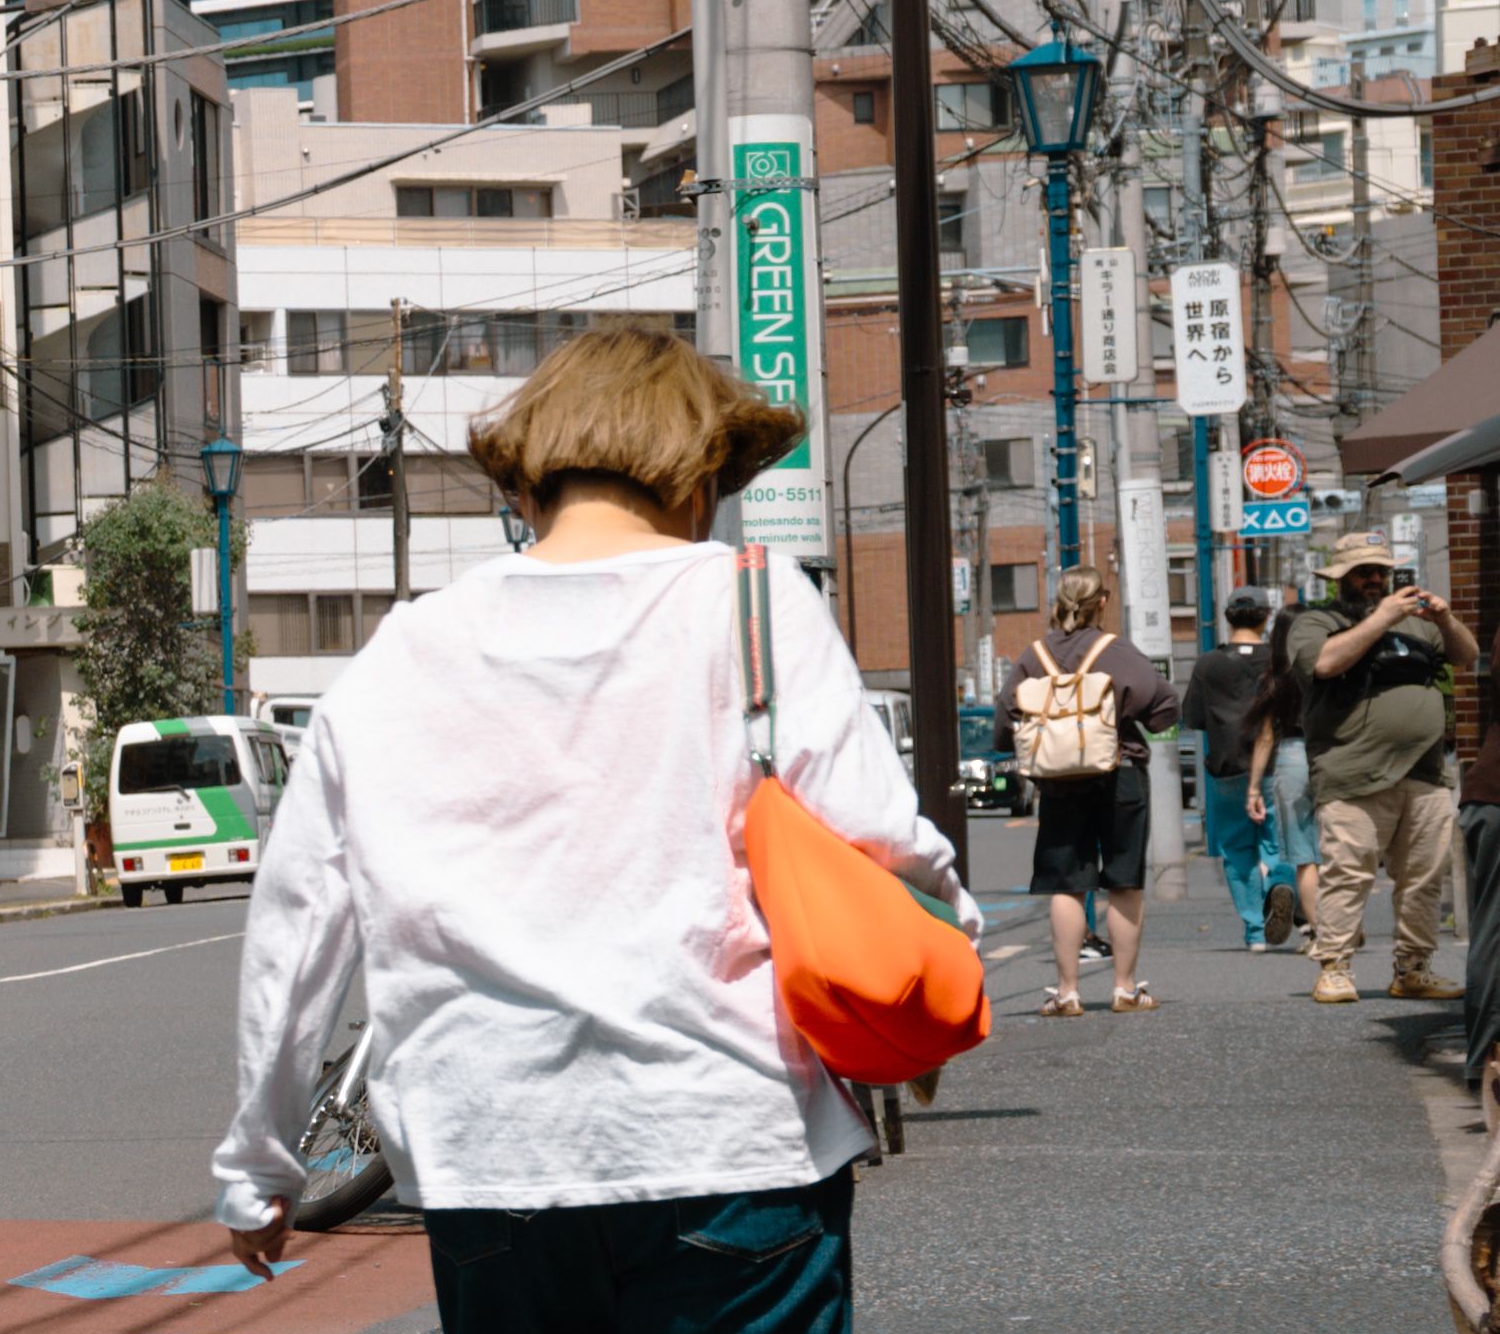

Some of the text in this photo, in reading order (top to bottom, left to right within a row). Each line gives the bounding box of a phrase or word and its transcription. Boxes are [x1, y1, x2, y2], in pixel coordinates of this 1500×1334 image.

[751, 202, 794, 344] GREEN
[1101, 270, 1117, 375] キラー通り商店会
[1184, 301, 1207, 362] 世界へ
[1209, 298, 1233, 385] 原宿から
